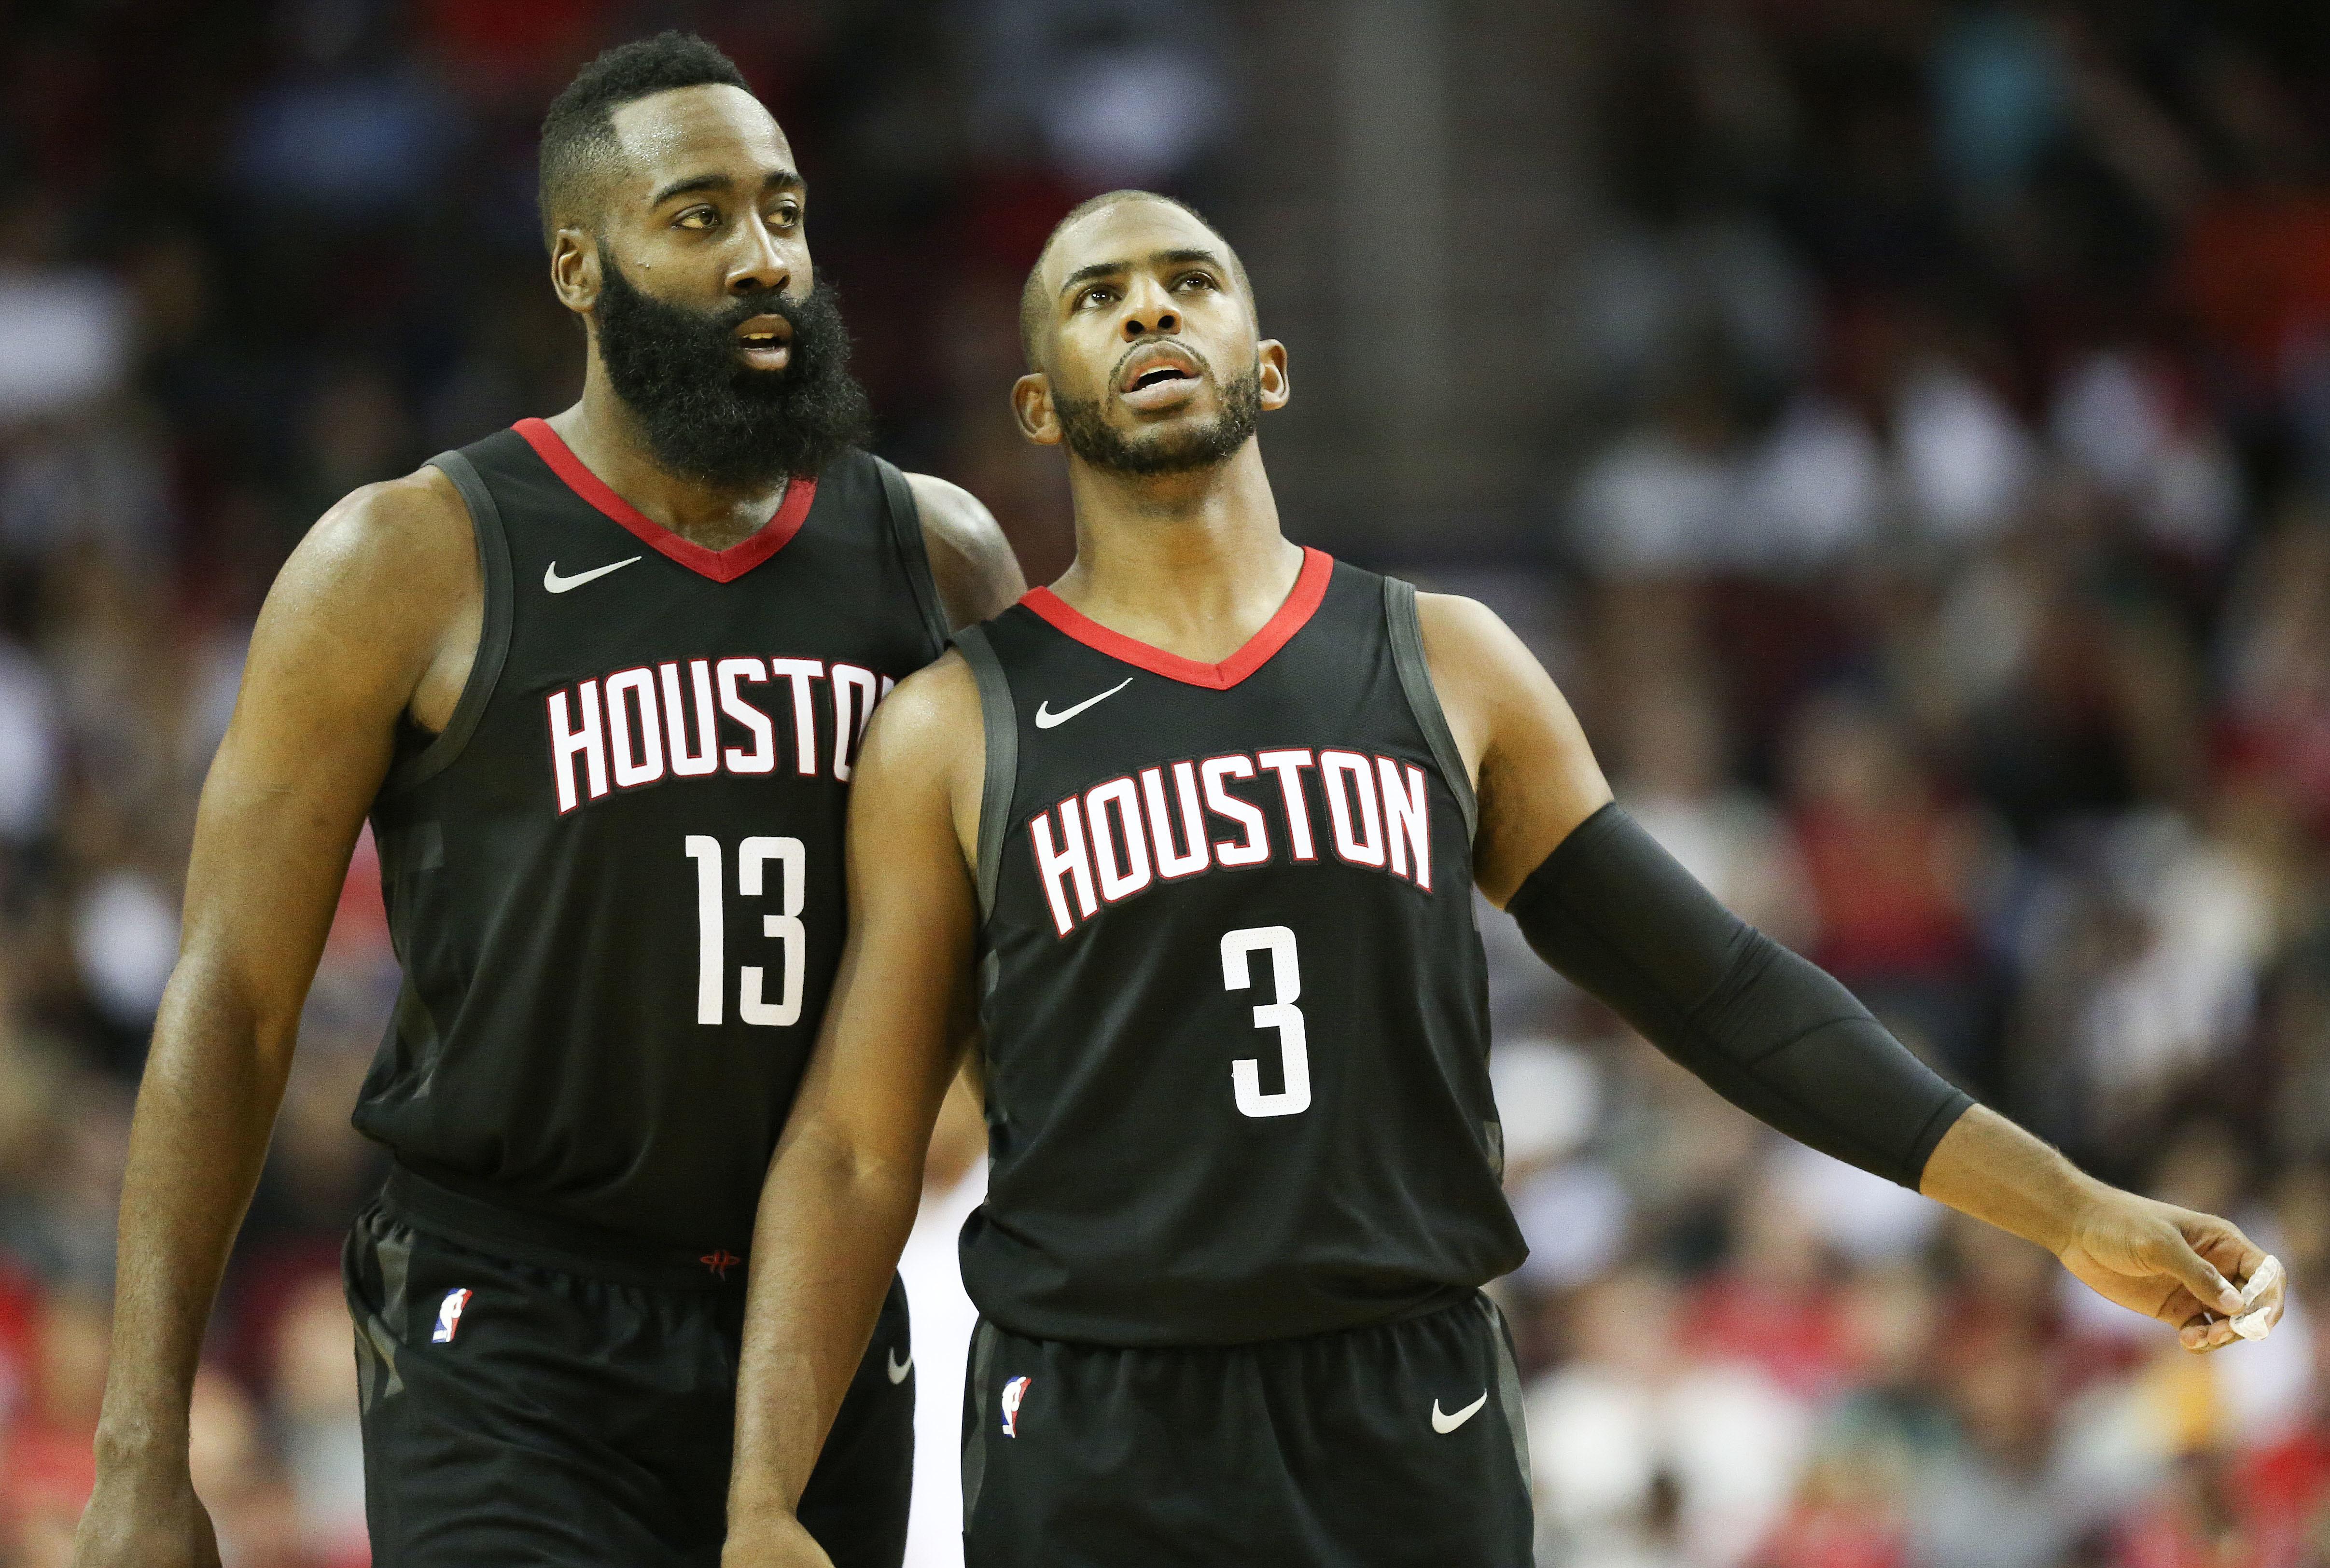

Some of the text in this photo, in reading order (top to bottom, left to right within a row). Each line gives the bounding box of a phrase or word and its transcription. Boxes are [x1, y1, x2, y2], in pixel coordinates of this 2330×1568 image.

[546, 656, 896, 815] HOUSTO
[685, 835, 805, 1026] 13
[1028, 749, 1432, 939] HOUSTON
[1220, 926, 1311, 1117] 3
